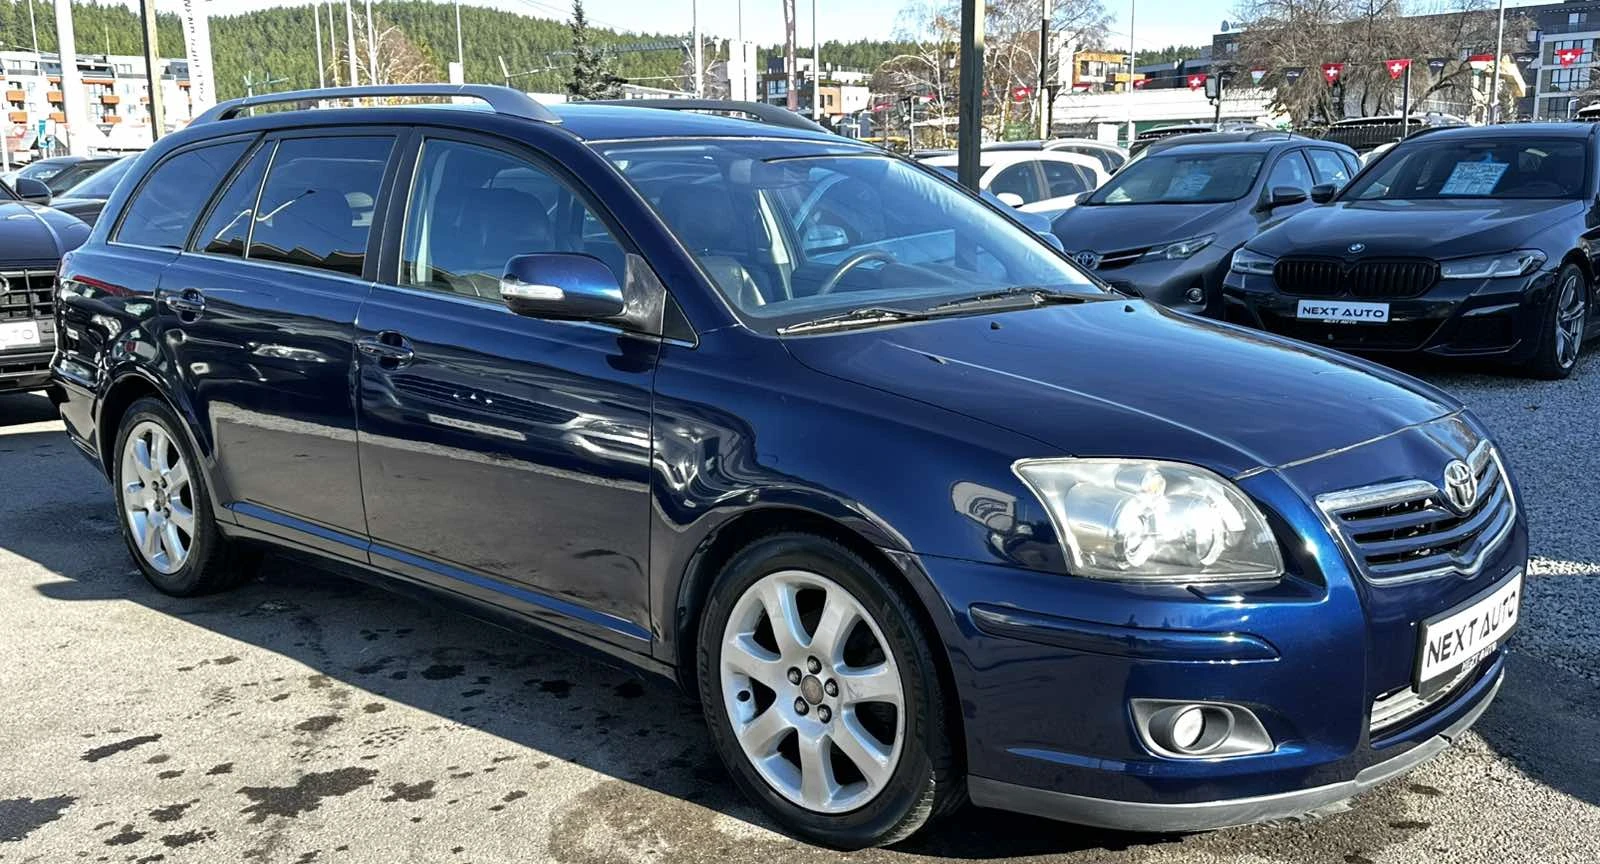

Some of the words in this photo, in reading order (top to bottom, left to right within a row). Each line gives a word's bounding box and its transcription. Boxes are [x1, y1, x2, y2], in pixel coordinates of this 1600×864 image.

[1302, 306, 1338, 316] NEXT
[1342, 308, 1385, 318] AUTO
[1426, 616, 1479, 668] NEXT
[1479, 590, 1516, 640] AUTO
